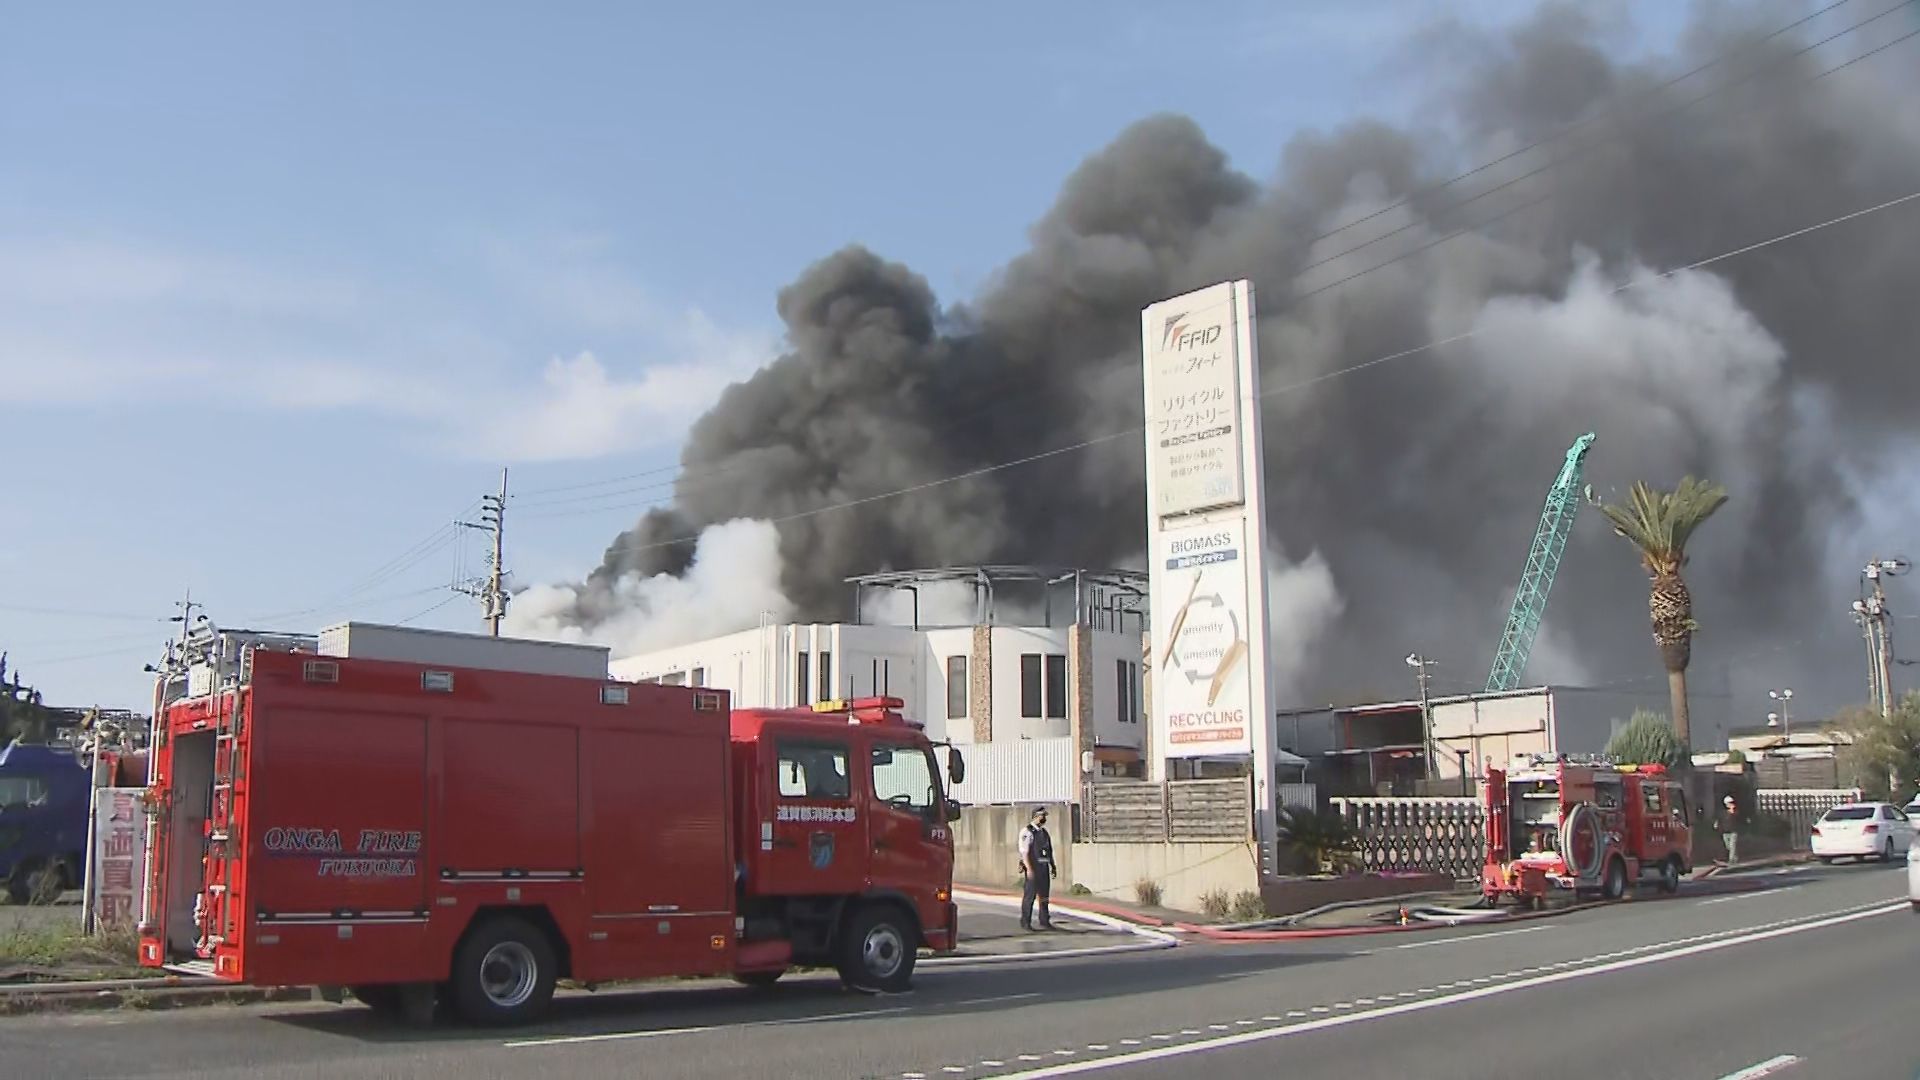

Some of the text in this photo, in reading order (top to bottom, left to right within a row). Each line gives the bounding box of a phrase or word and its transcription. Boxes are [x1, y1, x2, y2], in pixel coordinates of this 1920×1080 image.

[1163, 387, 1224, 412] リサイクル
[1158, 408, 1230, 434] ファクトリー
[1171, 532, 1231, 553] BIOMASS
[1169, 709, 1244, 727] RECYCLING
[264, 827, 422, 852] ONGA FIRE
[318, 858, 416, 877] FUKUOKA
